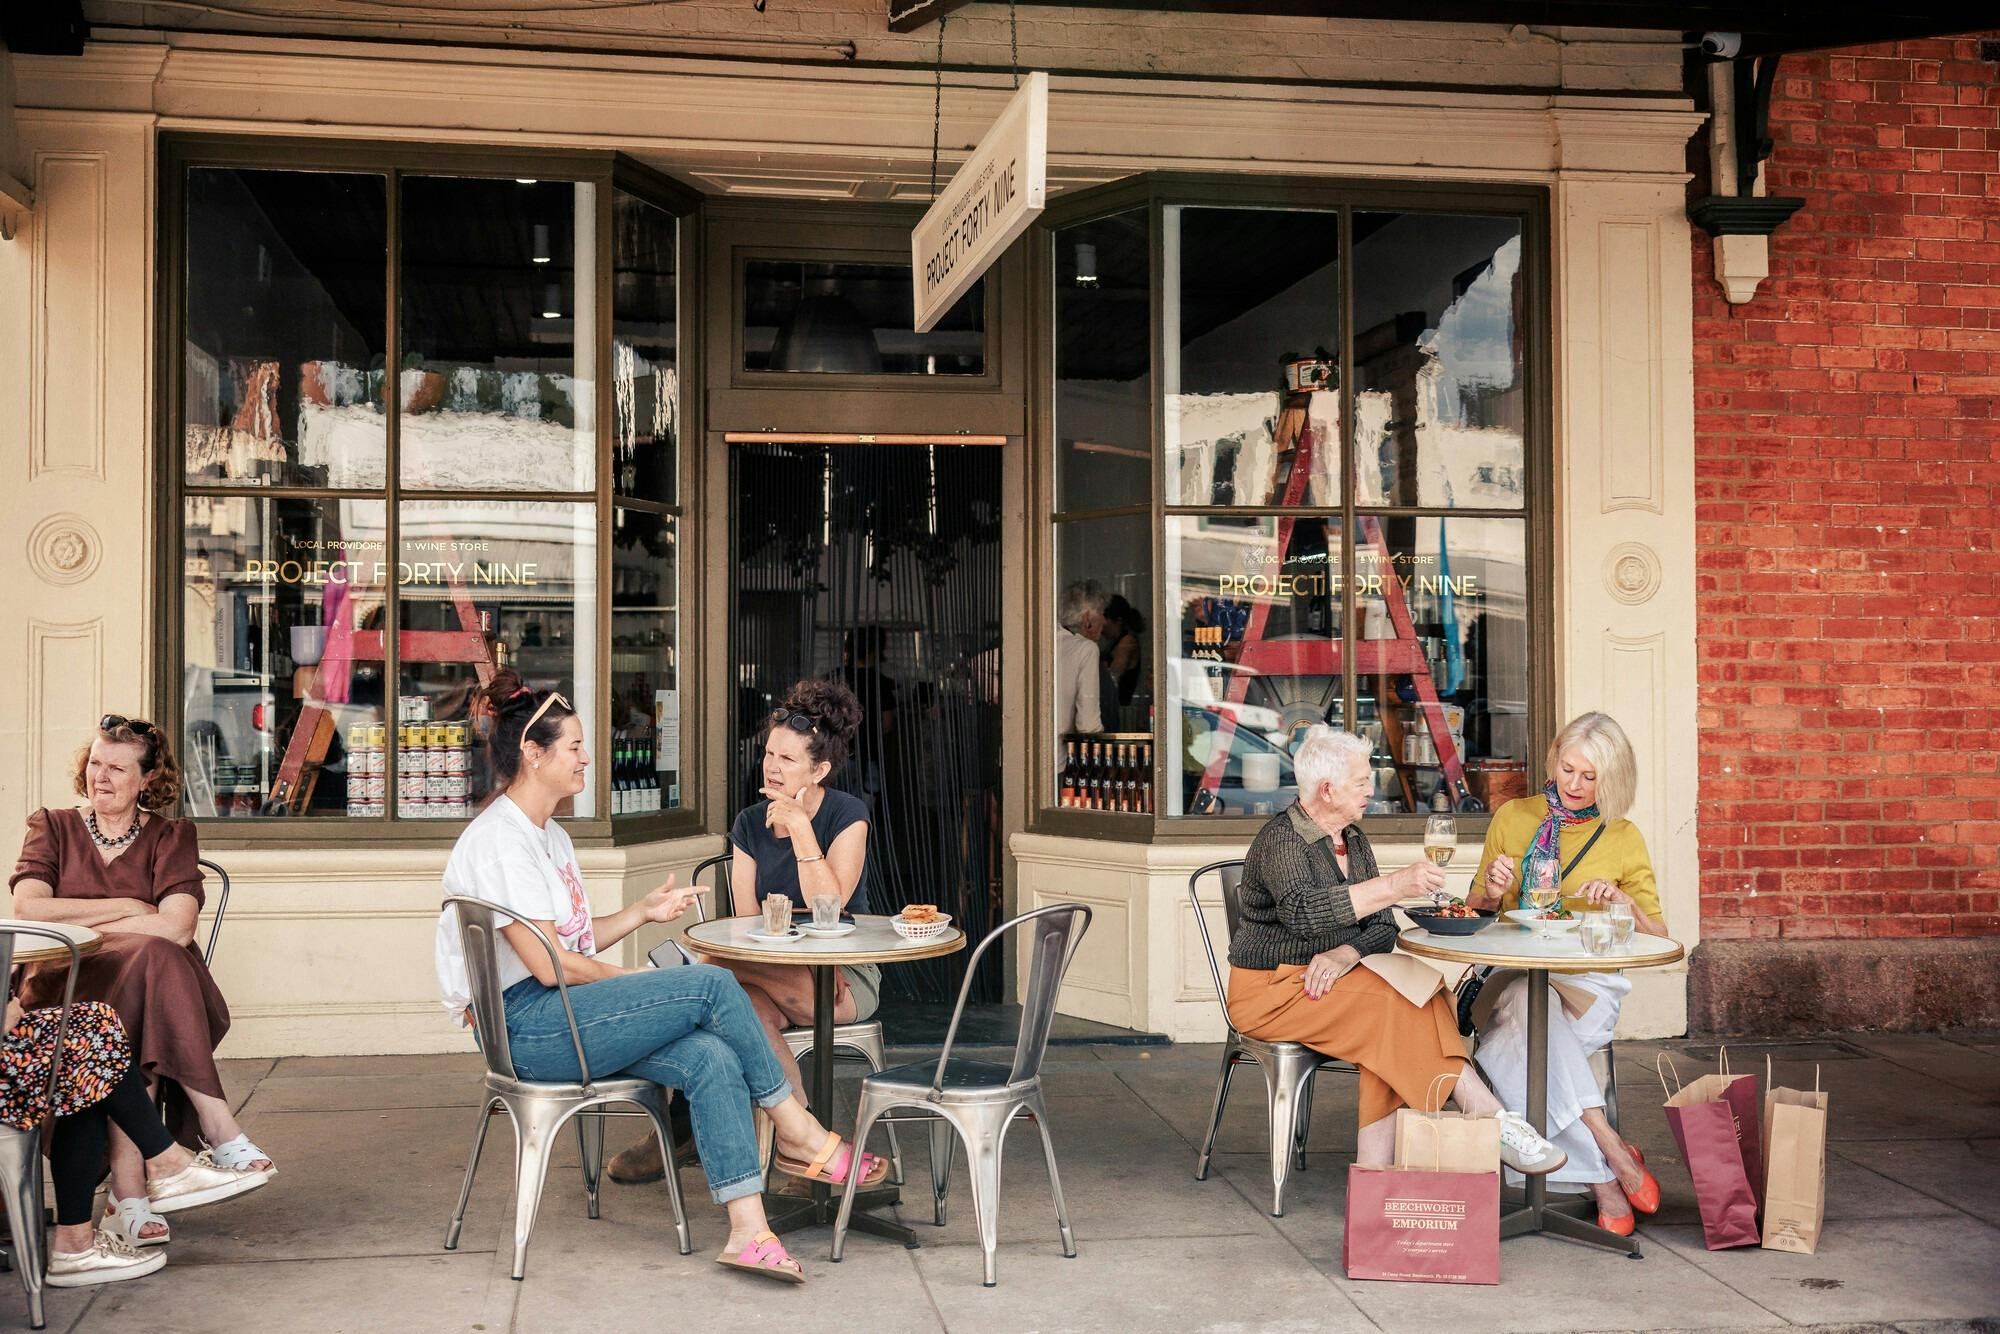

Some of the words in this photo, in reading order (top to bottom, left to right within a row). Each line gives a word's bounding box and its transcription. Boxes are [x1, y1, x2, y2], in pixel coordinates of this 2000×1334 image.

[926, 228, 959, 295] PROJECT
[962, 189, 991, 255] FORTY
[993, 157, 1016, 218] NINE
[294, 540, 325, 550] LOCAL
[327, 541, 382, 551] PROVIDORE
[415, 542, 447, 551] WINE
[450, 542, 489, 551] STORE
[1399, 555, 1435, 564] STORE
[246, 559, 364, 585] PROJECT
[373, 562, 464, 585] FORTY
[473, 562, 538, 585] NINE
[1219, 574, 1323, 596] PROJECT
[1419, 574, 1478, 596] NINE
[1384, 1202, 1466, 1213] BEECHWORTH
[1392, 1218, 1458, 1231] EMPORIUM
